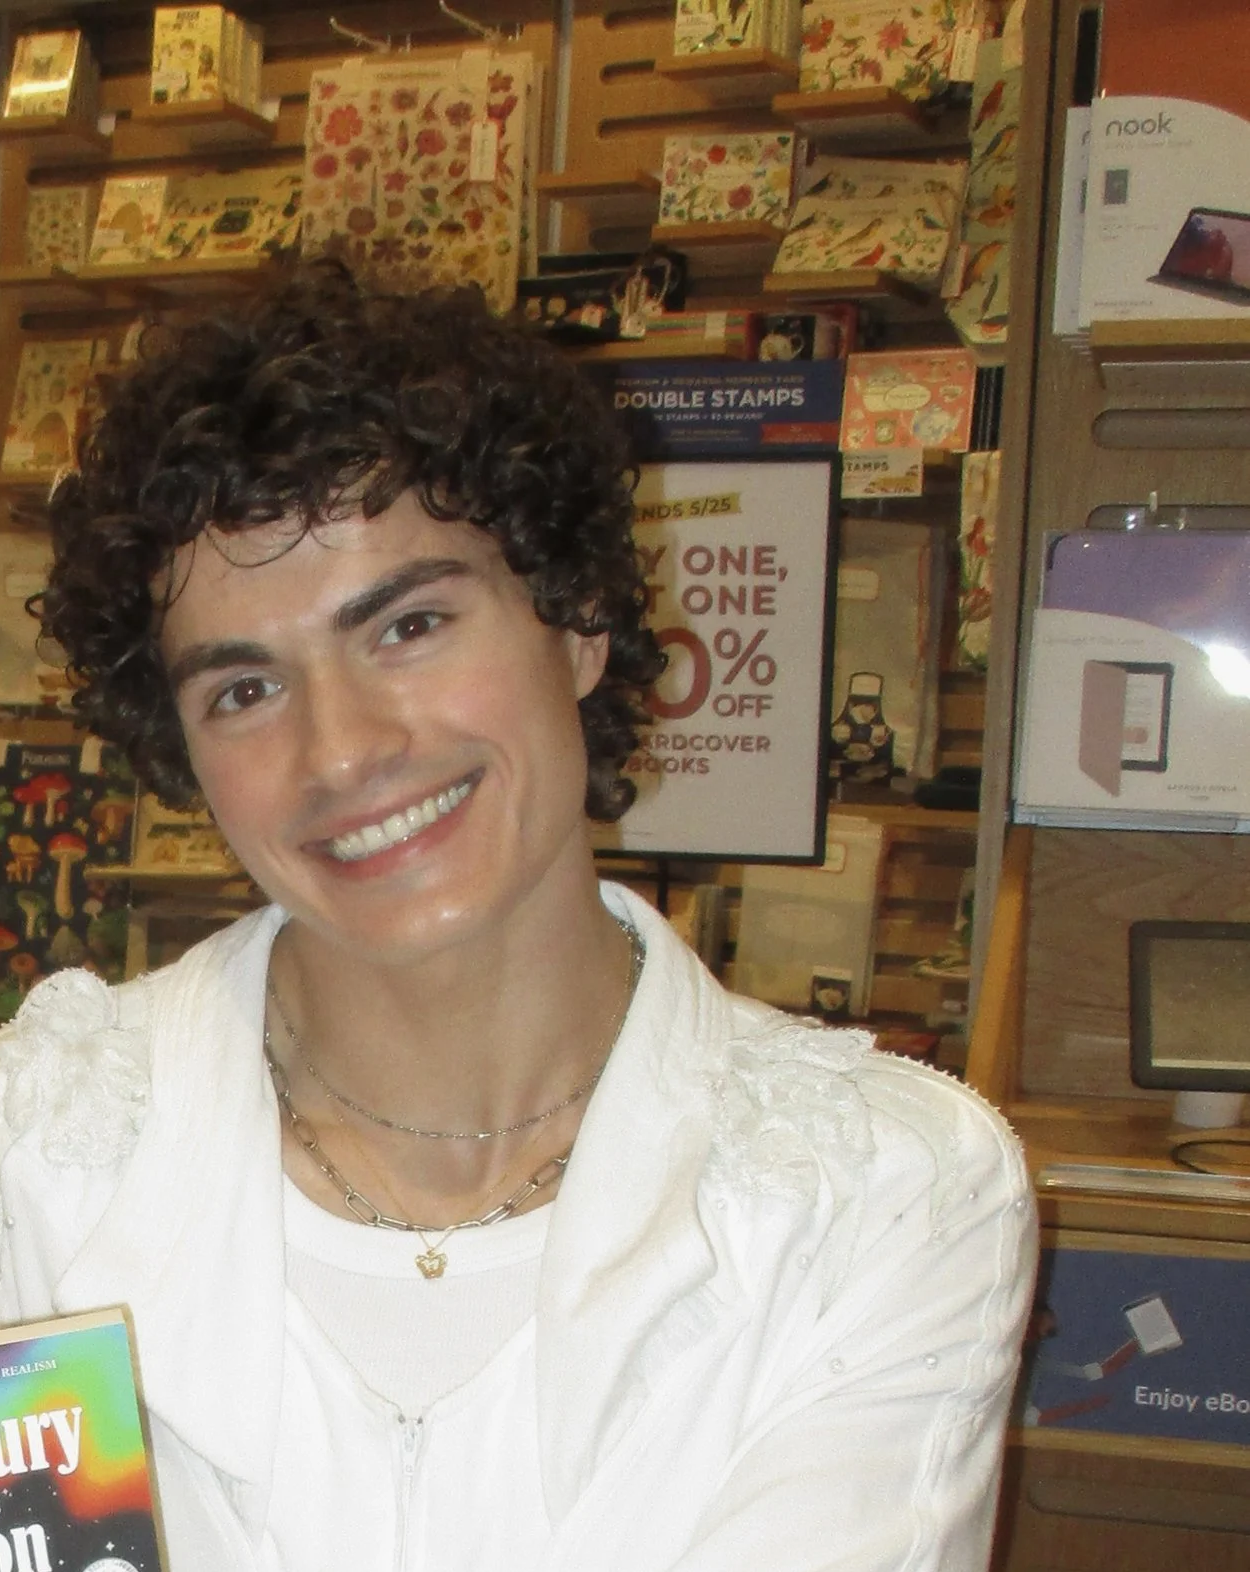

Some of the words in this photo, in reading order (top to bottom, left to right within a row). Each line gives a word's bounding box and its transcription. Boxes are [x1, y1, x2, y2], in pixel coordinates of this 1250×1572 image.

[1106, 112, 1174, 136] nook
[614, 390, 705, 410] DOUBLE
[711, 387, 806, 408] STAMPS
[689, 497, 732, 517] 5/25
[682, 545, 788, 582] ONE,
[681, 584, 778, 616] ONE
[711, 693, 774, 718] OFF
[626, 757, 711, 775] BOOKS
[2, 1358, 57, 1381] REALISM
[1134, 1385, 1200, 1412] Enjoy
